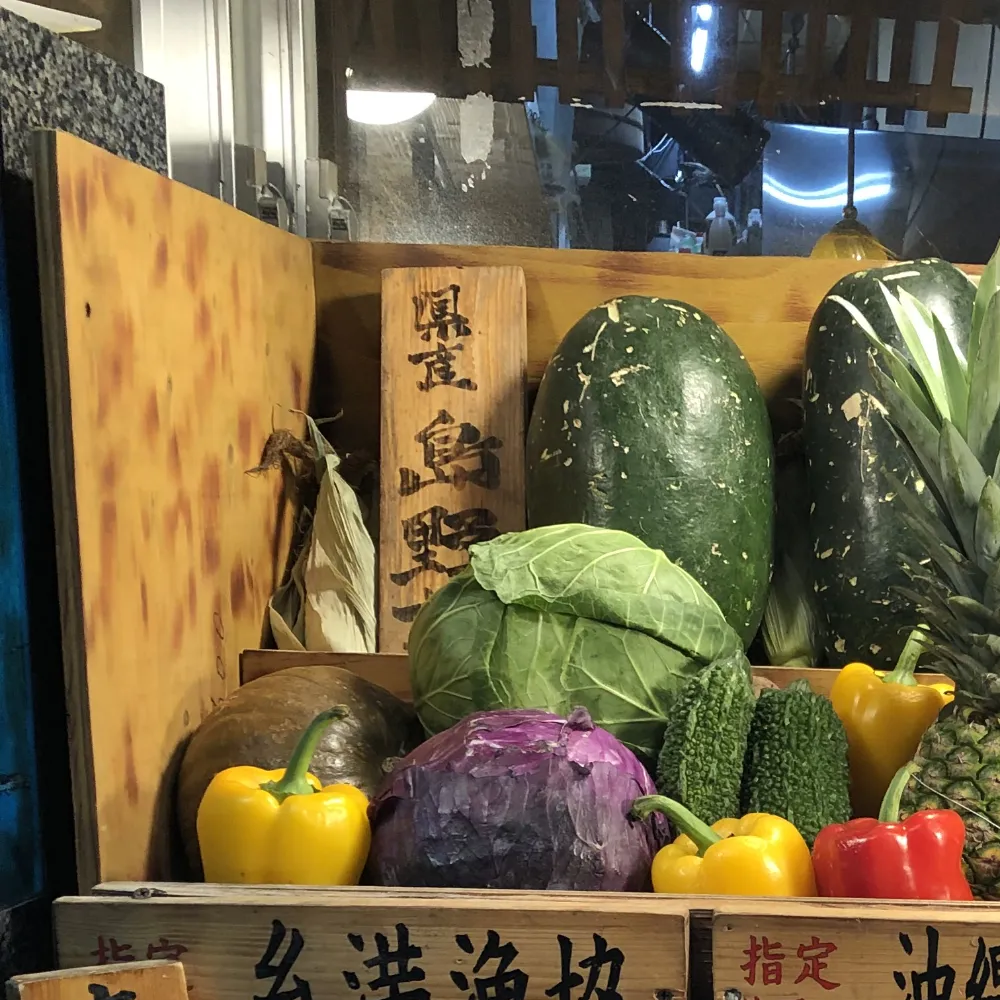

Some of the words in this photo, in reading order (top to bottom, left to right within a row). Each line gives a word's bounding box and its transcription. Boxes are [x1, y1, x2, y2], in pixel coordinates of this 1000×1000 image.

[390, 284, 503, 625] 県産島野
[740, 935, 842, 991] 指定
